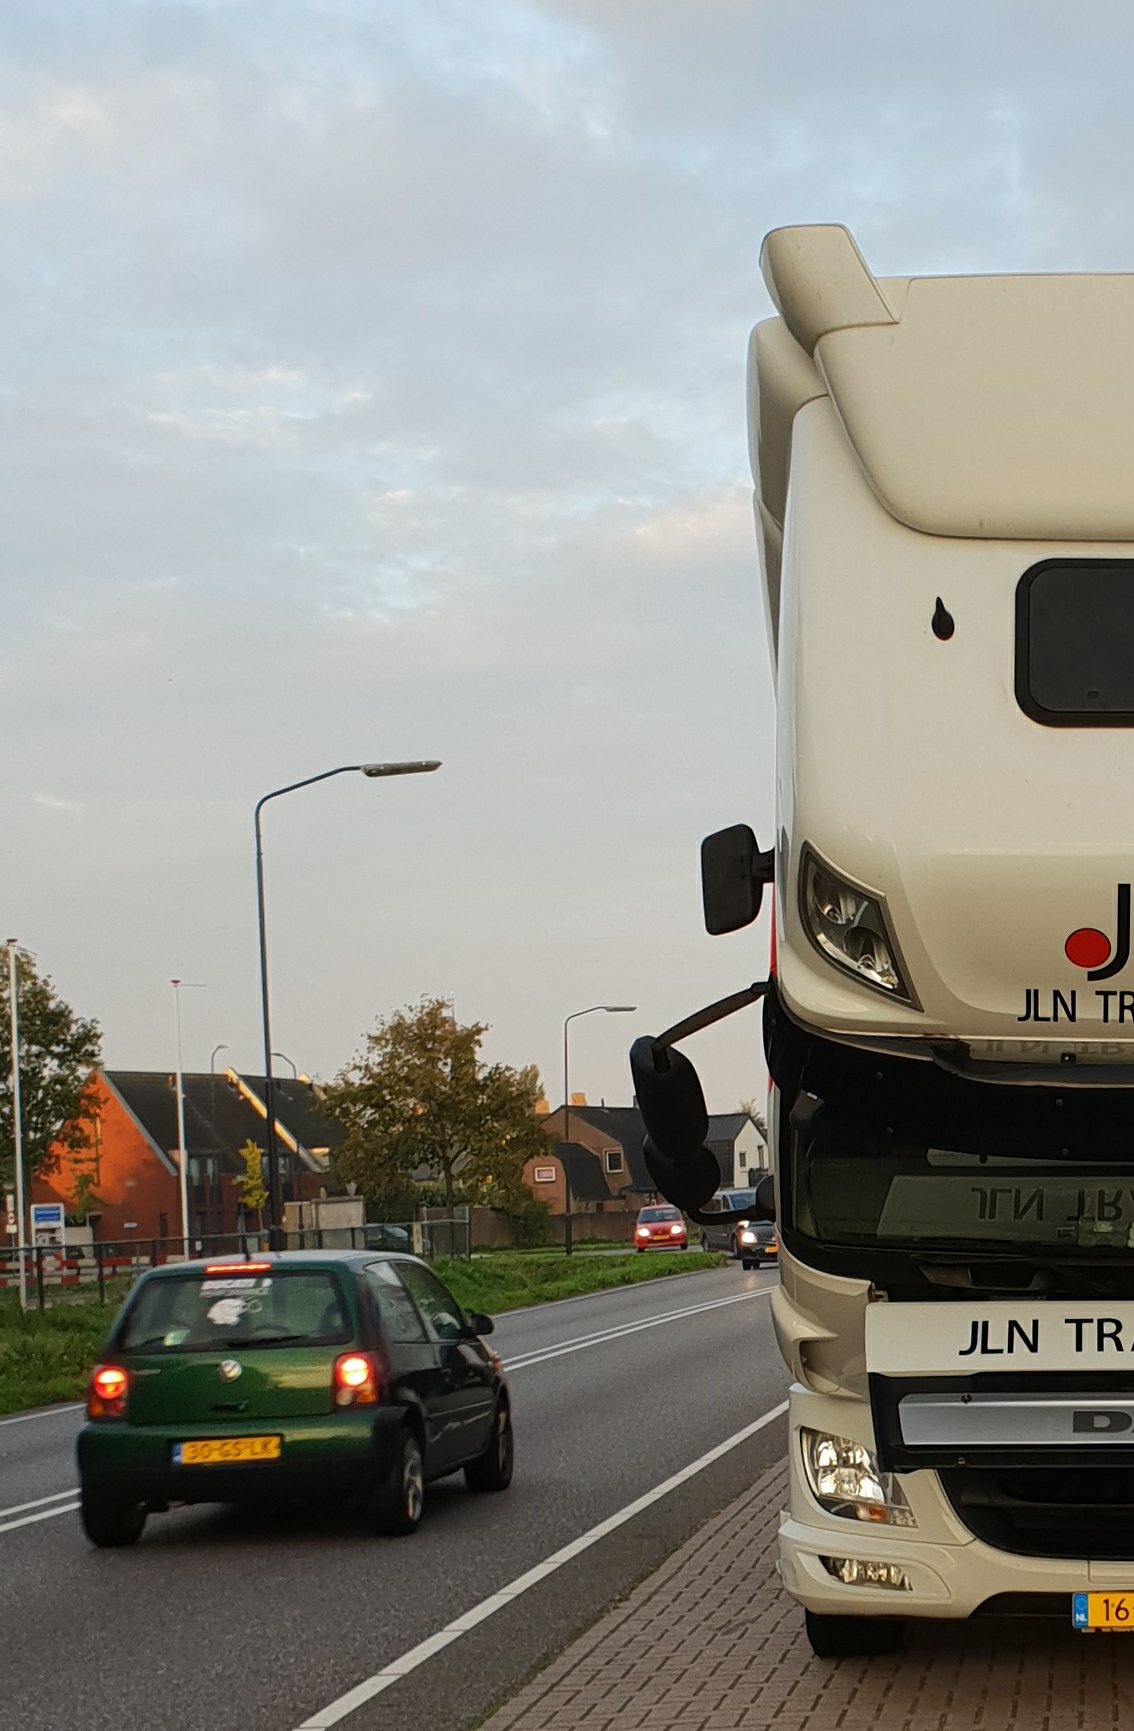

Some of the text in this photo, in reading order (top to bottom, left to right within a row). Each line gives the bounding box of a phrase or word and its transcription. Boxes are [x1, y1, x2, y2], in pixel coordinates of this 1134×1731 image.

[1017, 989, 1077, 1023] JLN
[958, 1319, 1040, 1357] JLN
[1075, 1612, 1087, 1622] NL
